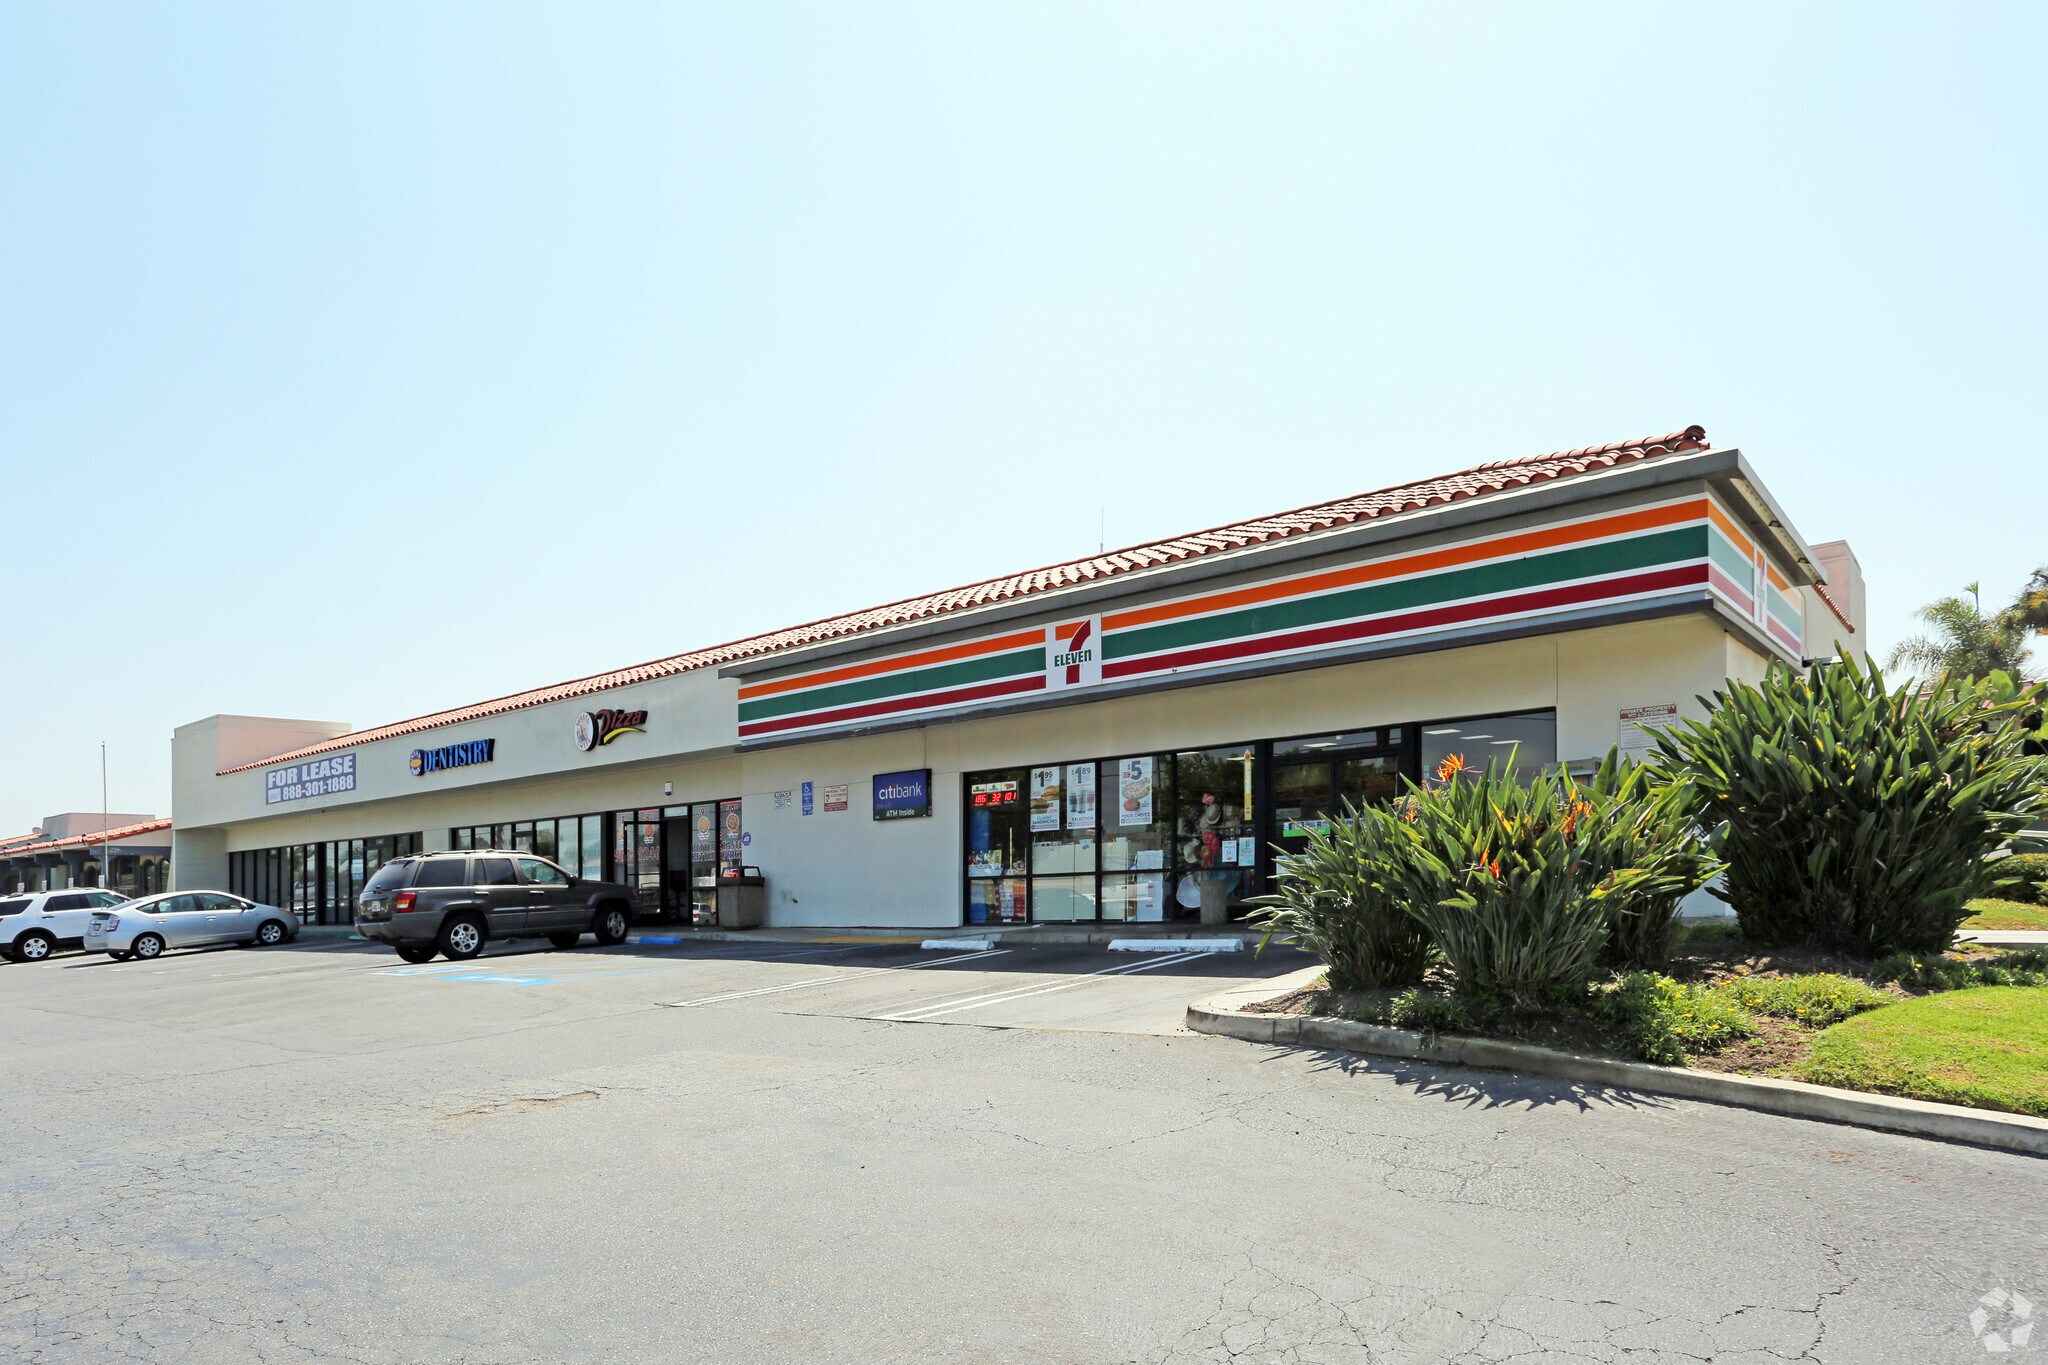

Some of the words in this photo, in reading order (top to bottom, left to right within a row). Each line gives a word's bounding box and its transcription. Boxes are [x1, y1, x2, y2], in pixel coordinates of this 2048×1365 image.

[1055, 619, 1091, 685] 7
[594, 709, 646, 746] Pizza
[267, 767, 298, 788] FOR
[301, 755, 354, 781] LEASE
[424, 739, 491, 773] DENTISTRY
[282, 774, 354, 801] 888-301-1888
[878, 781, 922, 800] citibank
[886, 810, 898, 818] ATM
[898, 808, 915, 816] Inside
